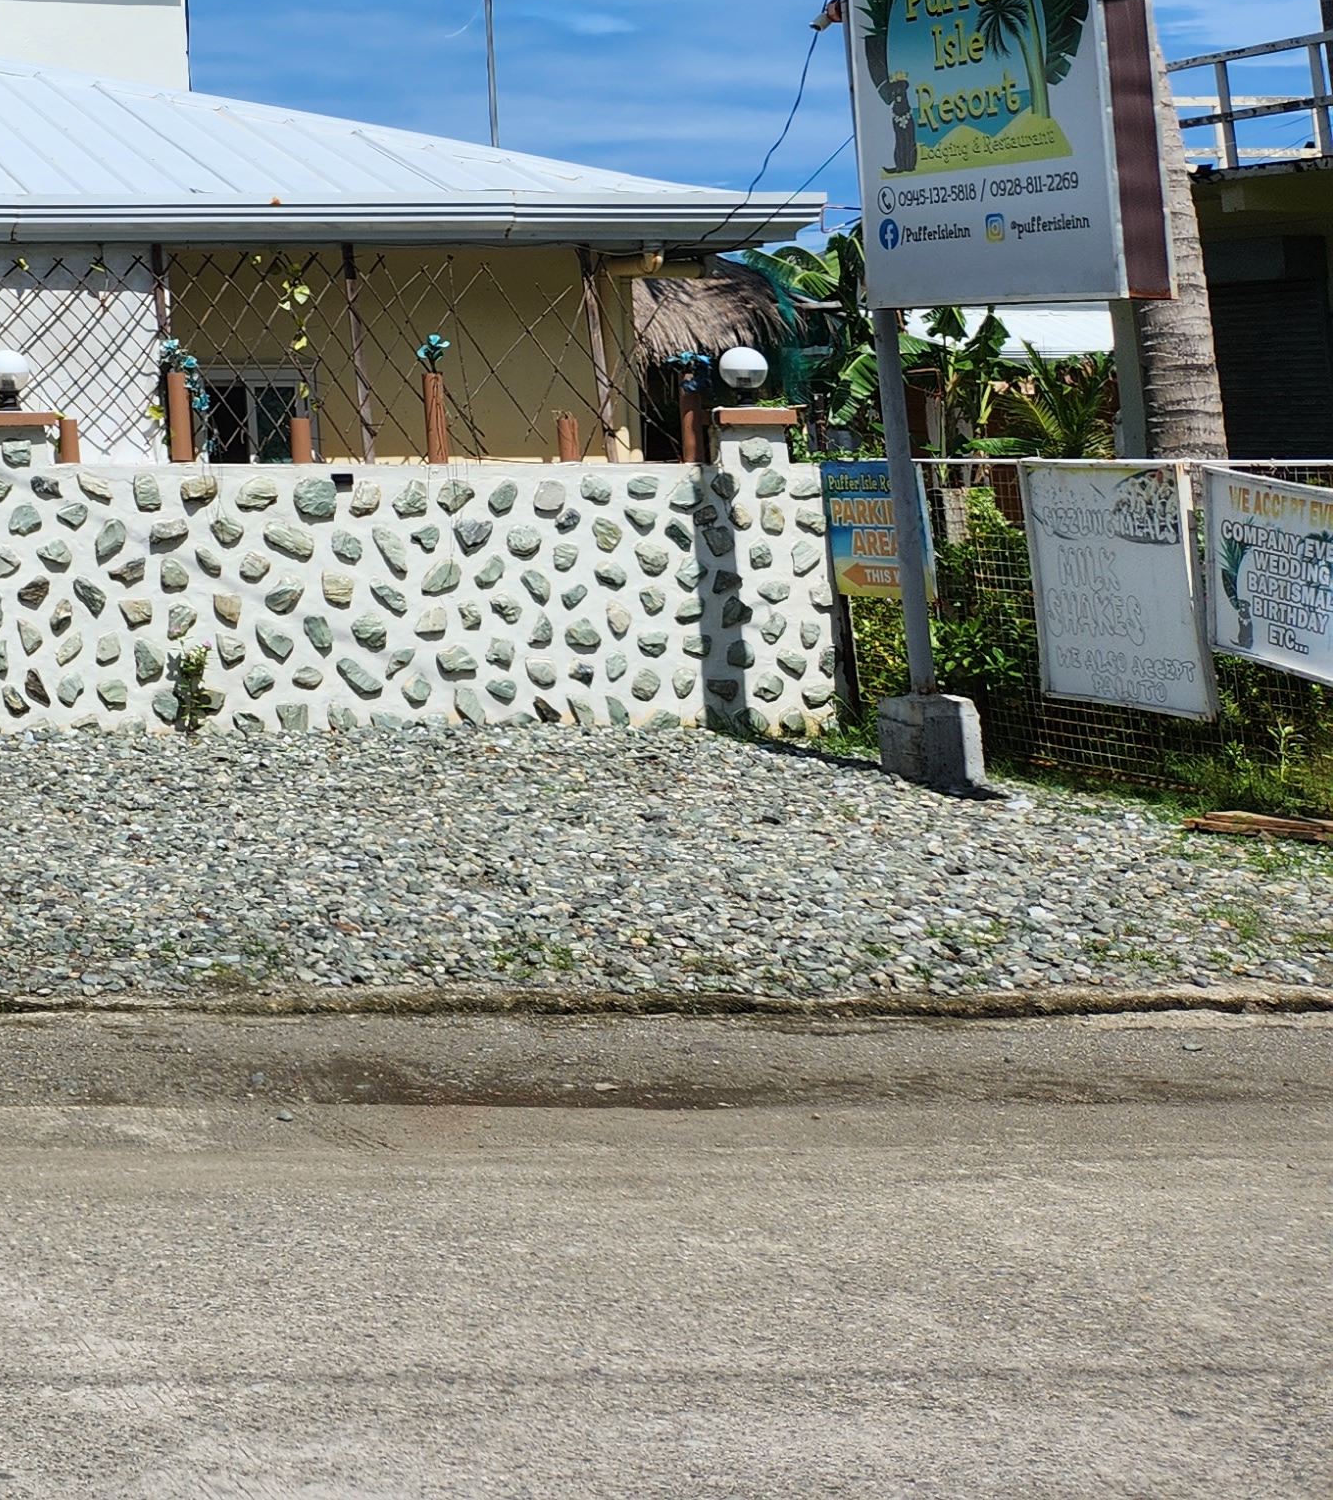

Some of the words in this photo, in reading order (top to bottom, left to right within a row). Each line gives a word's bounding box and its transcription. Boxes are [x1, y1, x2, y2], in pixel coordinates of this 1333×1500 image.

[932, 19, 984, 70] Isle
[916, 70, 1021, 132] Resort
[920, 139, 969, 163] Lodging
[982, 130, 1056, 155] Restaurant
[898, 183, 977, 207] 0945-132-5818
[990, 171, 1079, 197] 0928-811-2269
[1010, 213, 1091, 240] @pufferisleinn
[827, 472, 859, 492] Puffer
[860, 472, 878, 492] Isle
[1228, 485, 1251, 514] WE
[1042, 506, 1115, 539] SIZZLING
[1118, 510, 1177, 544] MEALS
[1221, 519, 1301, 556] COMPANY
[864, 568, 892, 584] THIS
[1058, 545, 1120, 592] MILK
[1253, 549, 1331, 587] WEDDING
[1047, 587, 1145, 646] SHAKES
[1253, 595, 1330, 635] BIRTHDAY
[1268, 622, 1309, 655] ETC...
[1056, 645, 1082, 669] WE
[1085, 649, 1128, 676] ALSO
[1132, 655, 1196, 682] ACCEPT
[1091, 673, 1168, 703] PALUTO
